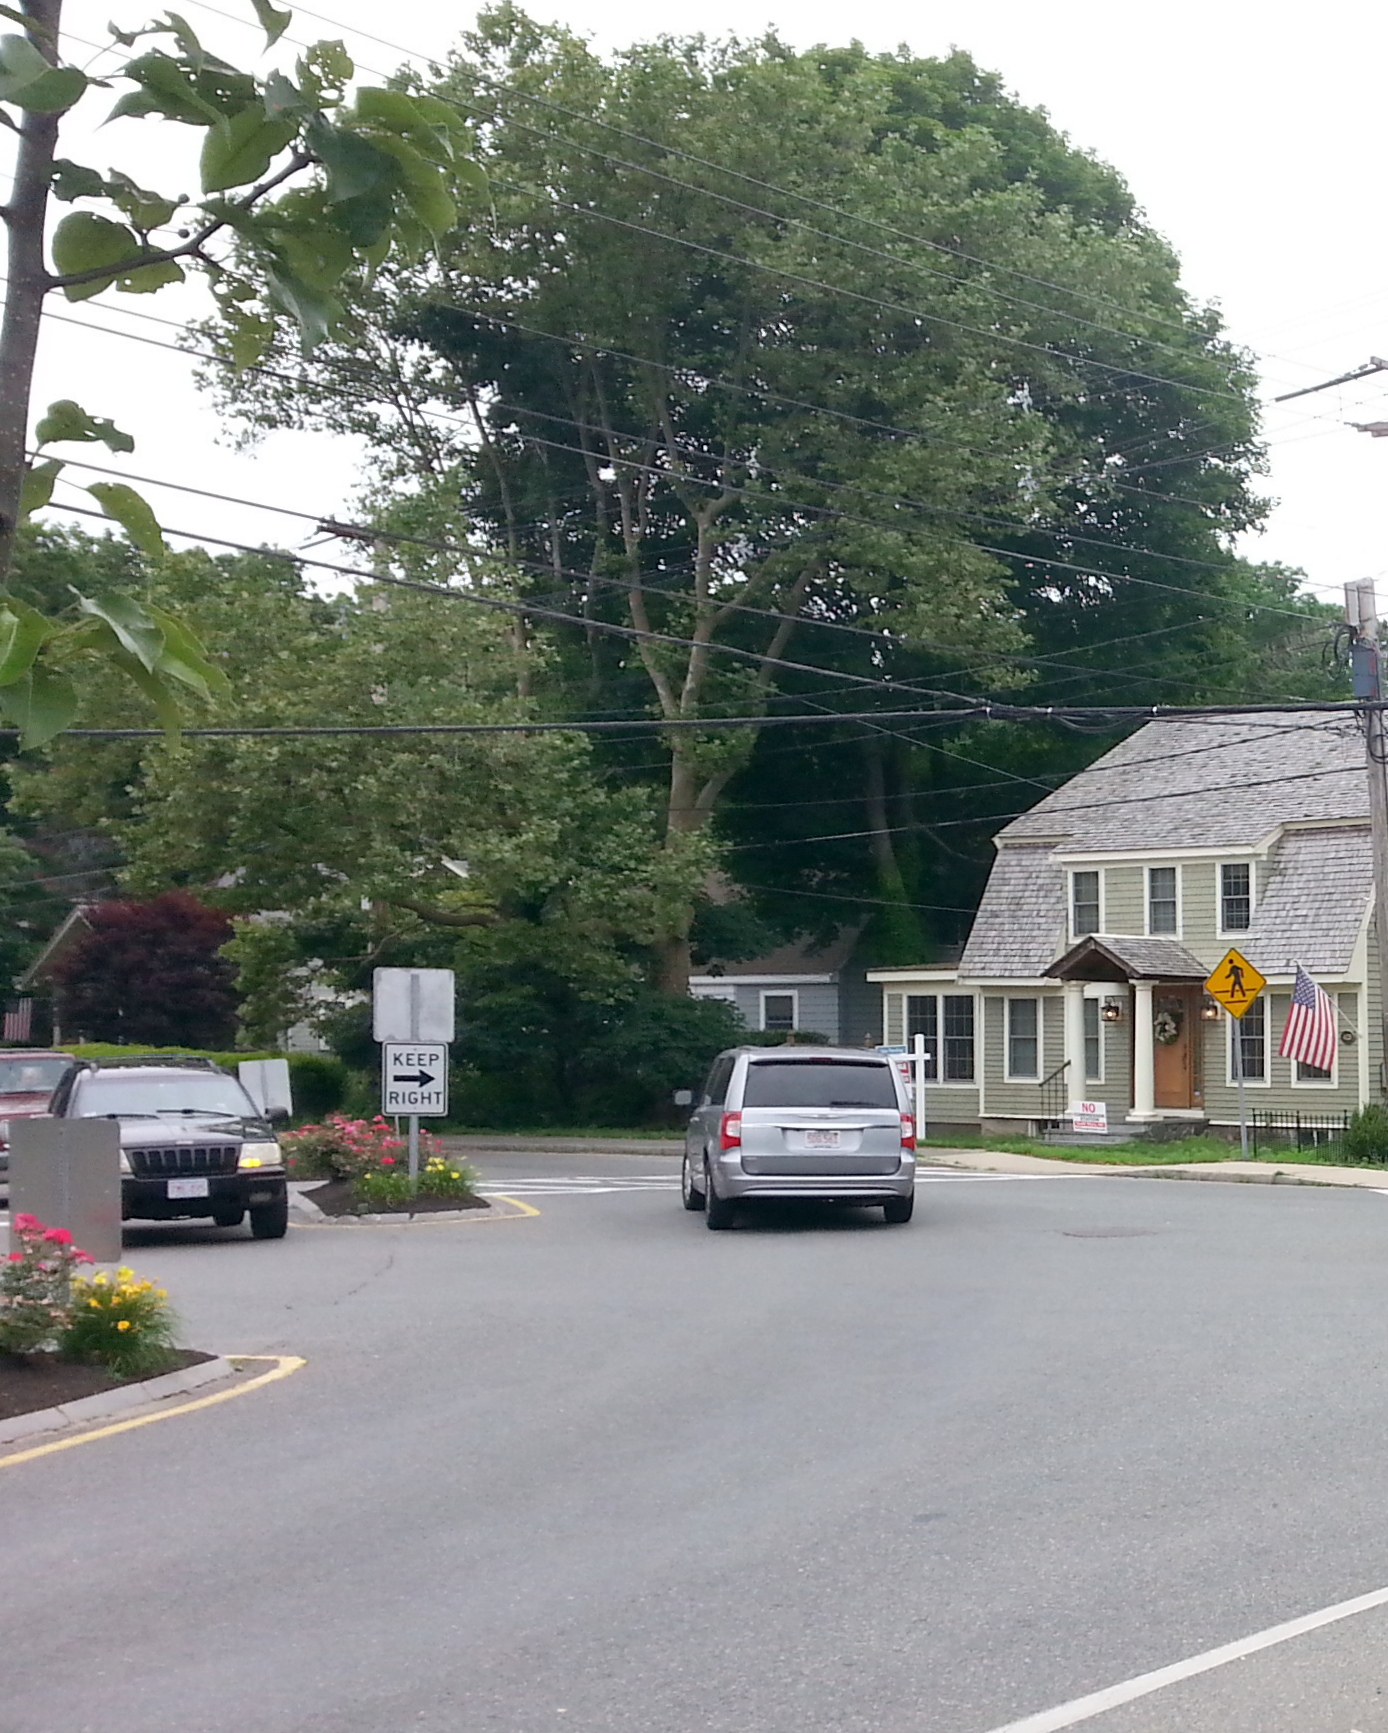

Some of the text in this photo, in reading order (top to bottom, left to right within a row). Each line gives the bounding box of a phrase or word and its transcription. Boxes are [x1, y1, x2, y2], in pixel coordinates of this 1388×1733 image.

[393, 1053, 439, 1066] KEEP
[389, 1091, 442, 1105] RIGHT
[1082, 1103, 1096, 1113] NO
